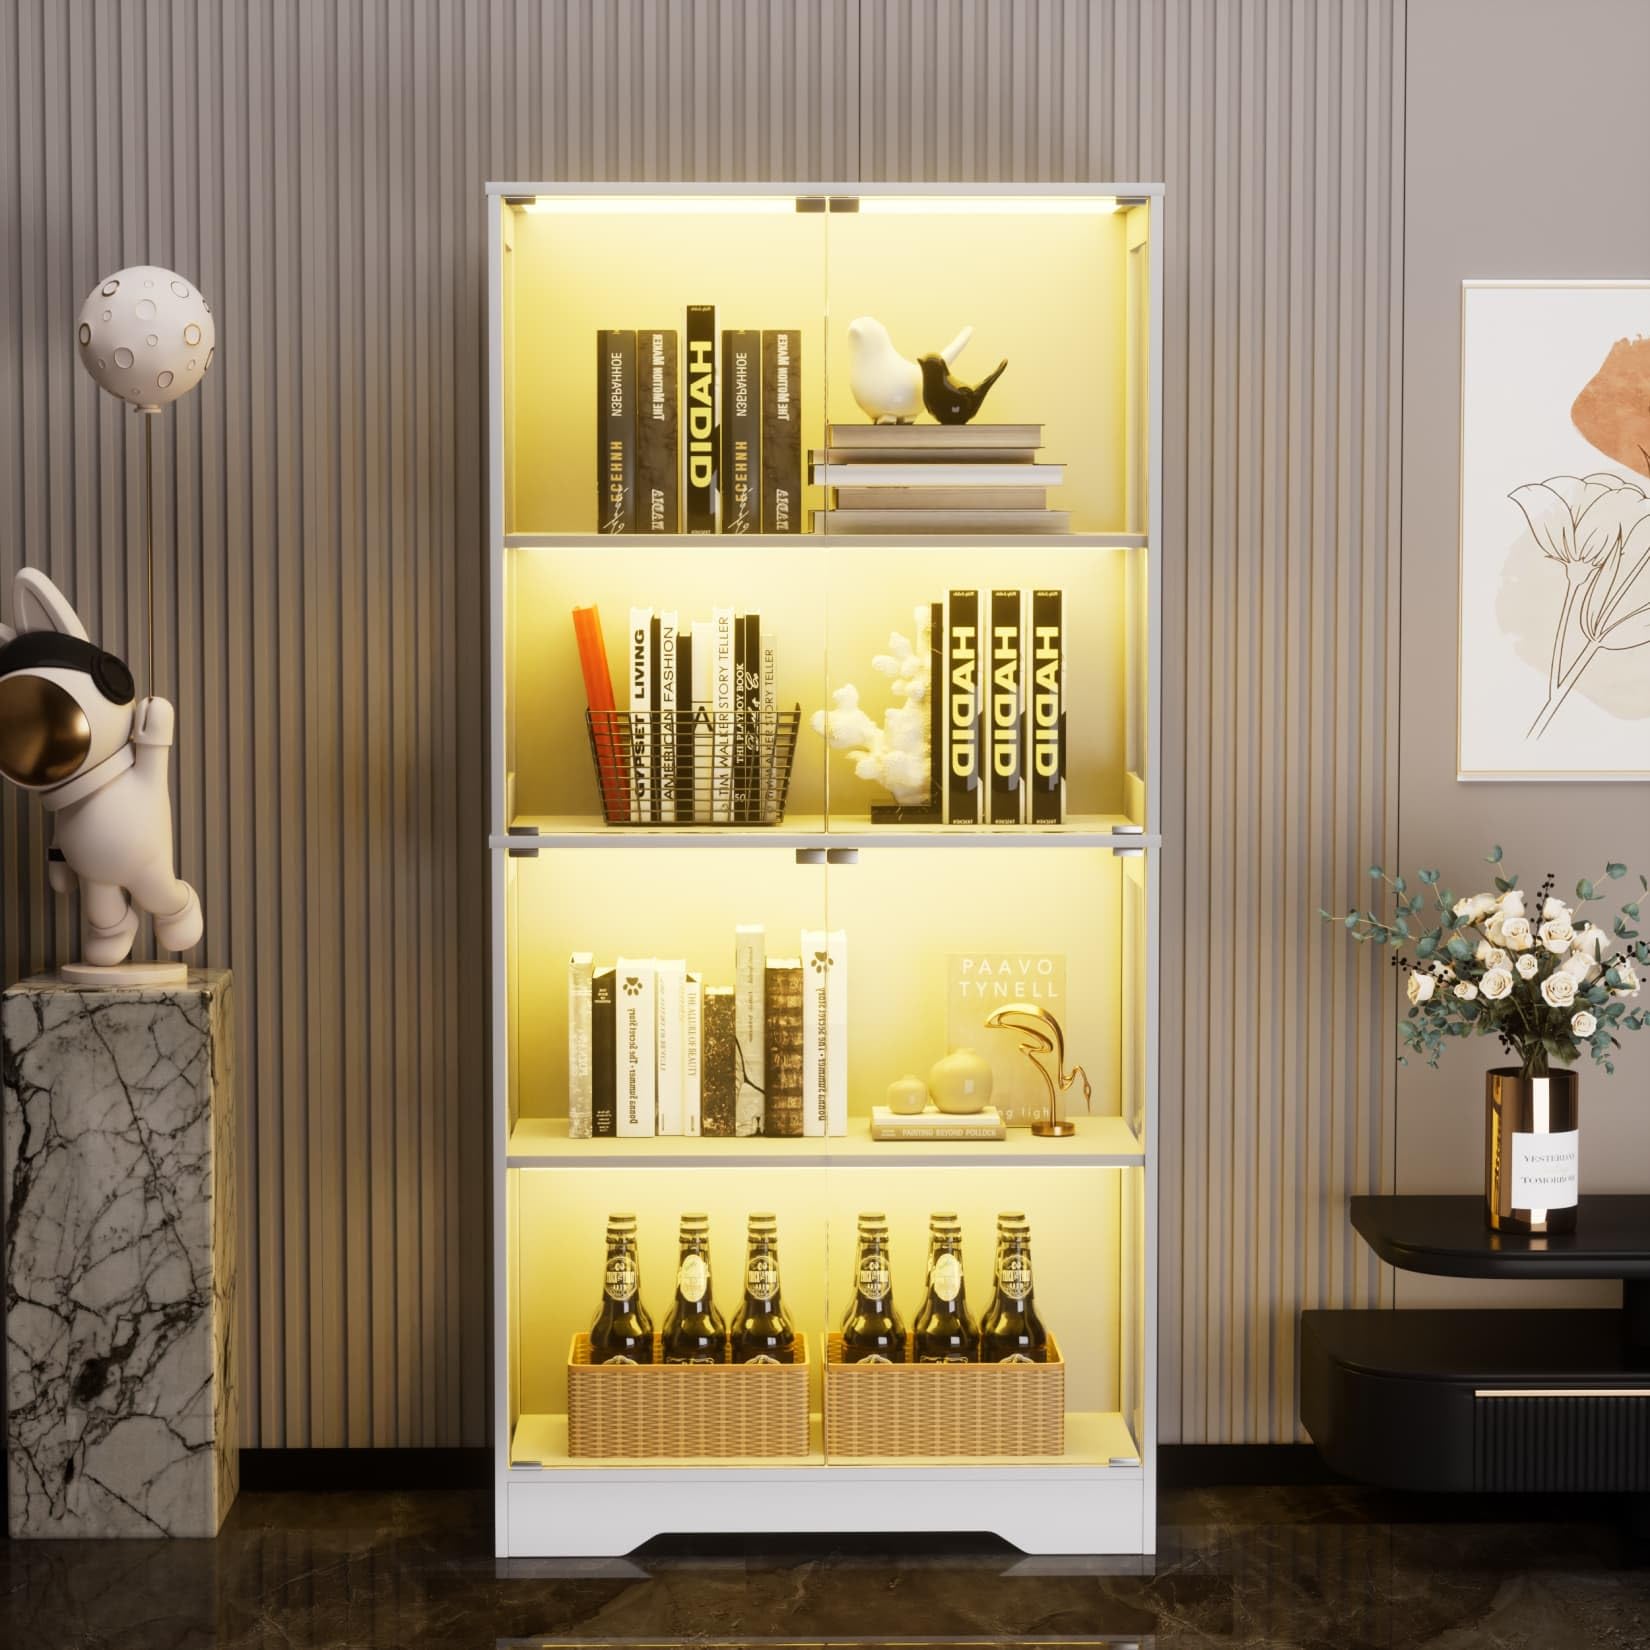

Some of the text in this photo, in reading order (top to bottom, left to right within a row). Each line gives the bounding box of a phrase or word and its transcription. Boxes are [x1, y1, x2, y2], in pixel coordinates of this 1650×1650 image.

[718, 616, 728, 661] TELLER
[736, 663, 744, 692] BOOK
[764, 649, 774, 685] TELLER
[719, 666, 728, 708] STORY
[634, 629, 646, 797] GYPSET LIVING
[663, 627, 674, 800] AMERICAN FASHION
[719, 713, 728, 770] WALKER
[719, 776, 728, 796] TIM
[962, 959, 1054, 976] PAAVO
[960, 981, 1058, 998] TYNELL
